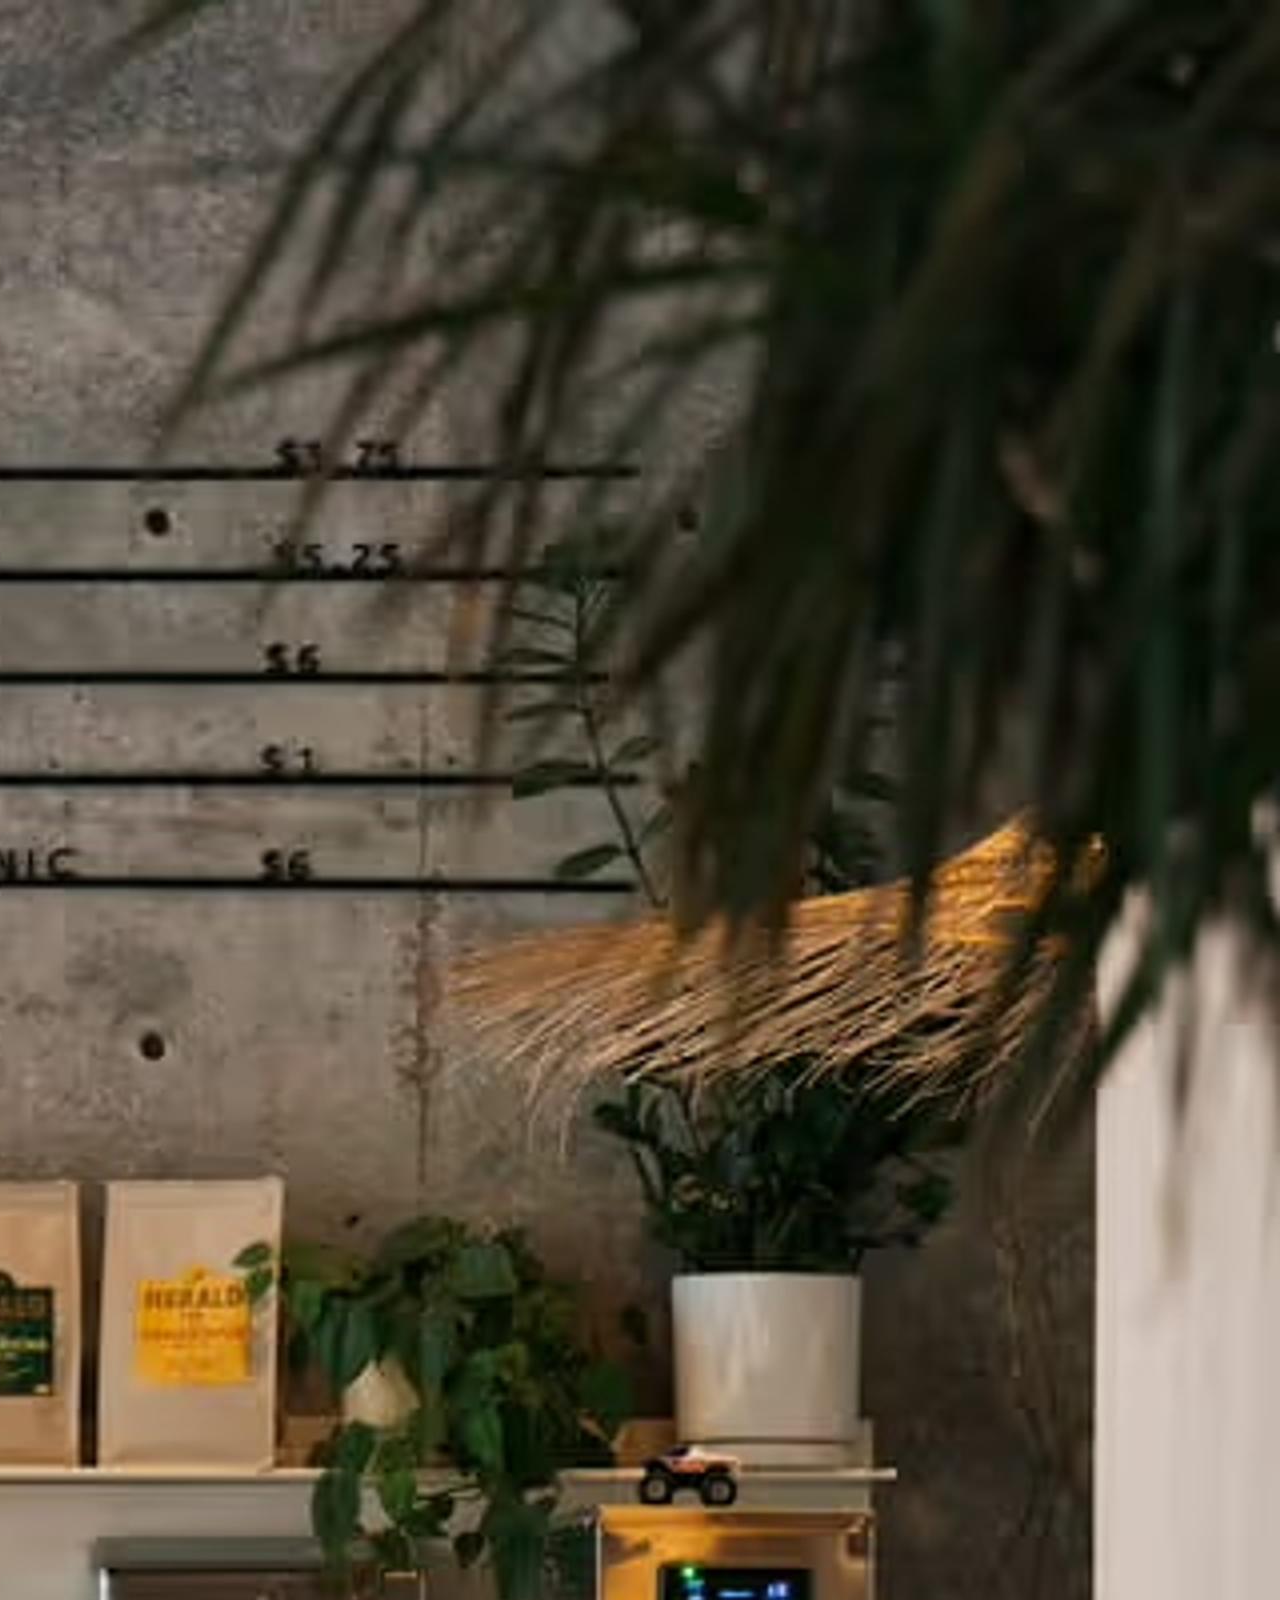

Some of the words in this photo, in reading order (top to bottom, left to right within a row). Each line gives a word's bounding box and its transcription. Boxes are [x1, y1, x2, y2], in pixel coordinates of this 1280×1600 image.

[264, 642, 321, 674] $6
[261, 744, 316, 775] $1
[259, 848, 314, 880] $6
[143, 1284, 247, 1310] HERALD
